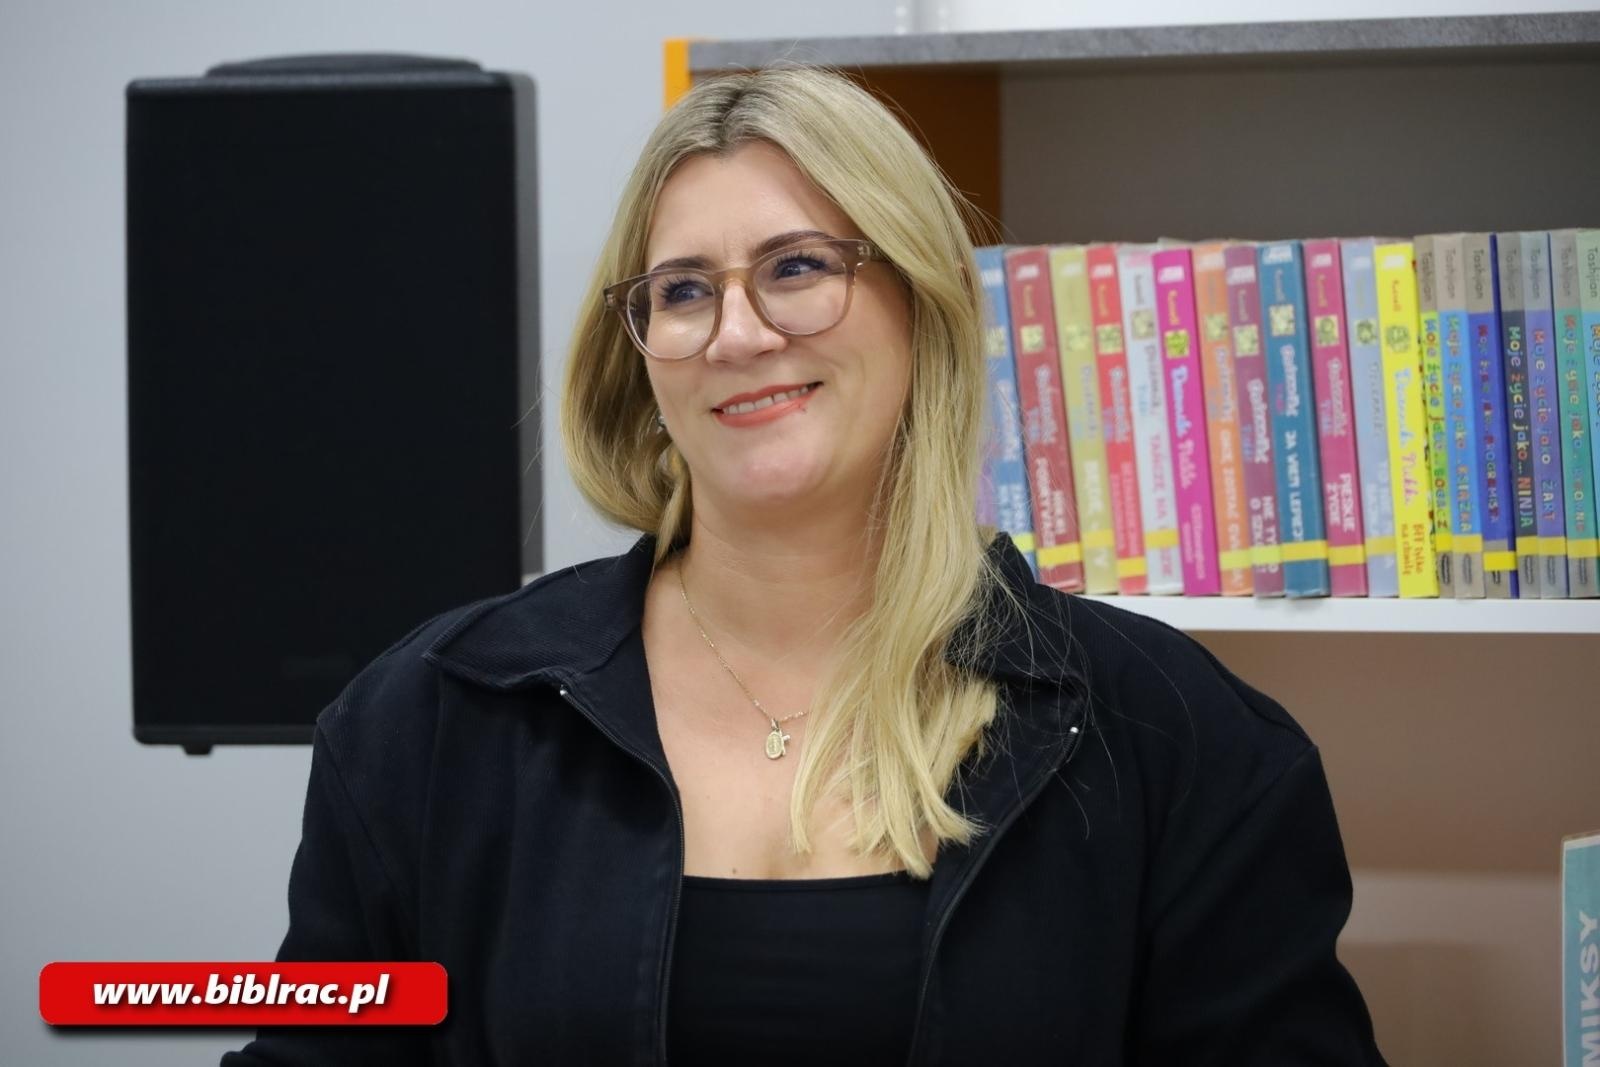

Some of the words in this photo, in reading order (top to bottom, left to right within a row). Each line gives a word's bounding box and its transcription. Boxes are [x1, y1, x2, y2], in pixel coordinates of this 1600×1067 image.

[1472, 249, 1486, 299] Tashjian
[1505, 248, 1518, 299] Tashjian
[1529, 248, 1542, 299] Tashjian
[1583, 247, 1598, 298] Tashjian
[1507, 326, 1523, 367] Moje
[1562, 315, 1578, 353] Moje
[1508, 372, 1527, 418] życie
[1531, 330, 1546, 370] Moje
[1541, 479, 1558, 521] ŻART
[1517, 477, 1534, 528] NINJA
[1265, 526, 1278, 573] TYO
